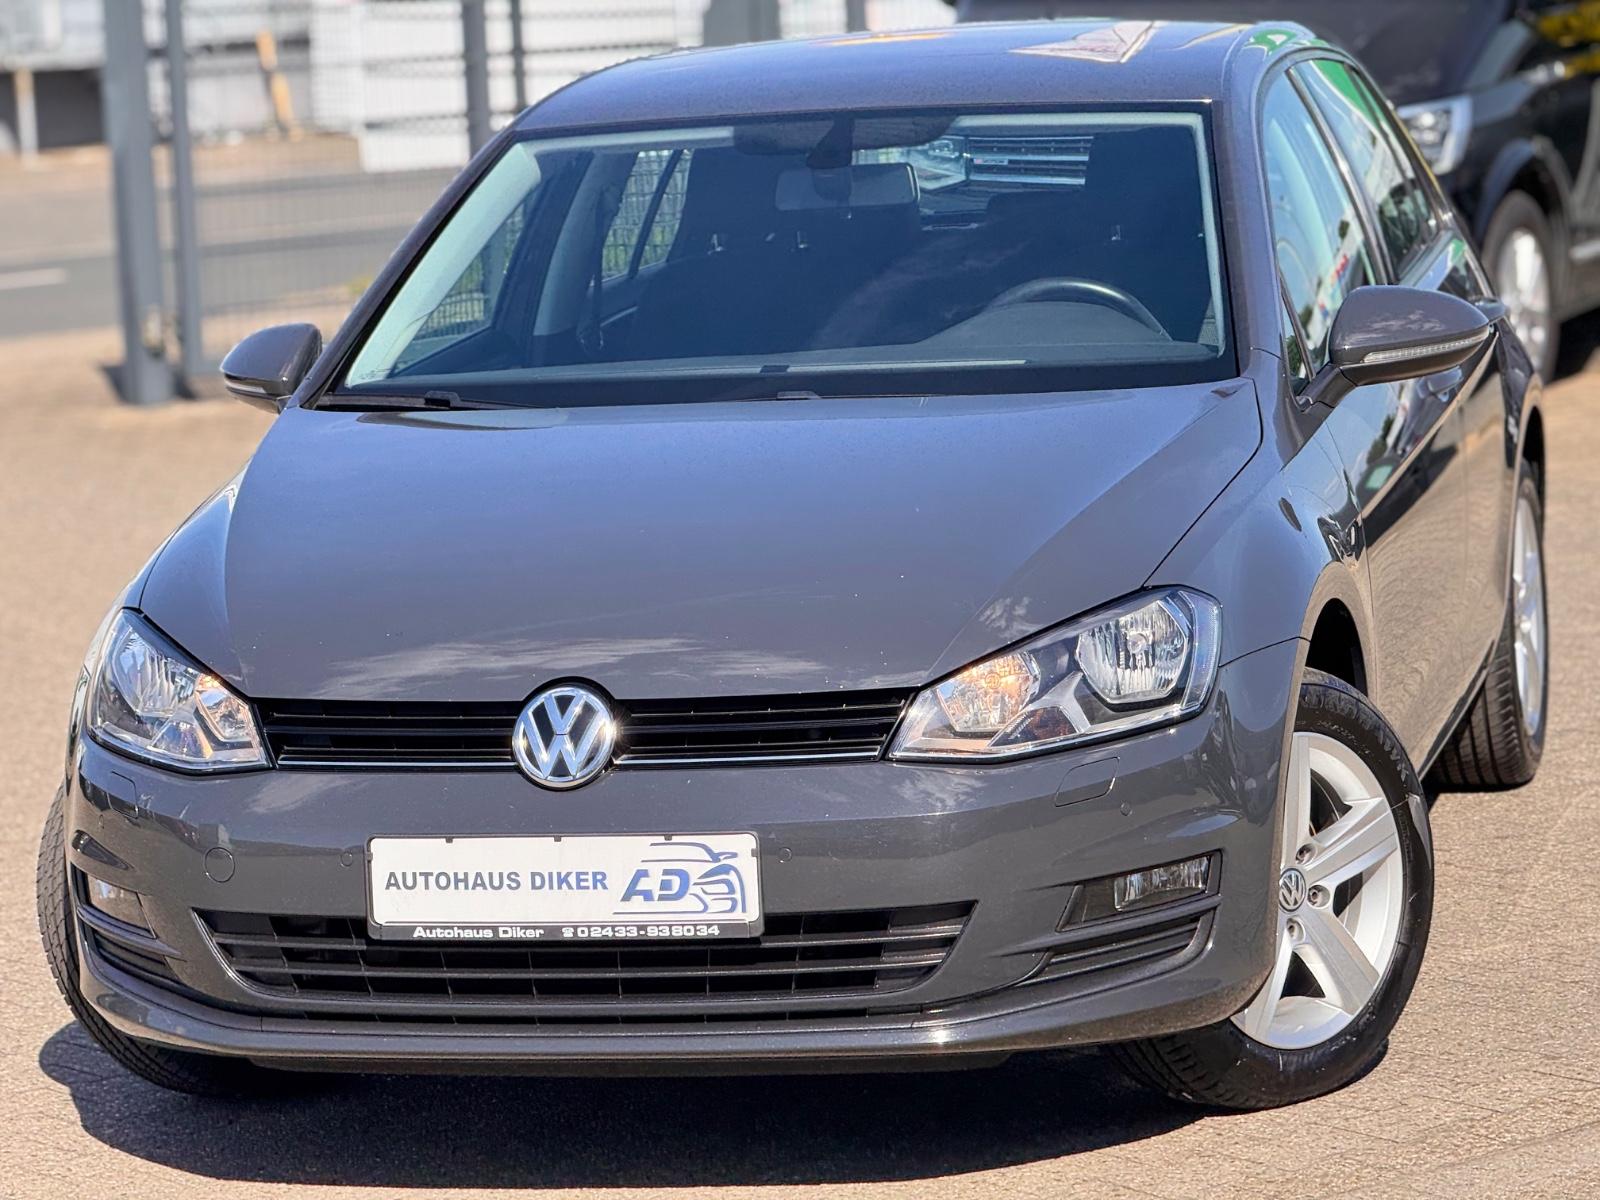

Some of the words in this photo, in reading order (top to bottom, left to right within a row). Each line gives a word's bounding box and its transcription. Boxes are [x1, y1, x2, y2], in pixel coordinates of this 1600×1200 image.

[515, 690, 612, 783] VW
[384, 871, 522, 891] AUTOHAUS
[530, 871, 608, 891] DIKER
[620, 869, 690, 902] AD
[413, 926, 494, 938] Autohaus
[498, 926, 545, 938] Diker
[577, 925, 721, 938] 02433-938034
